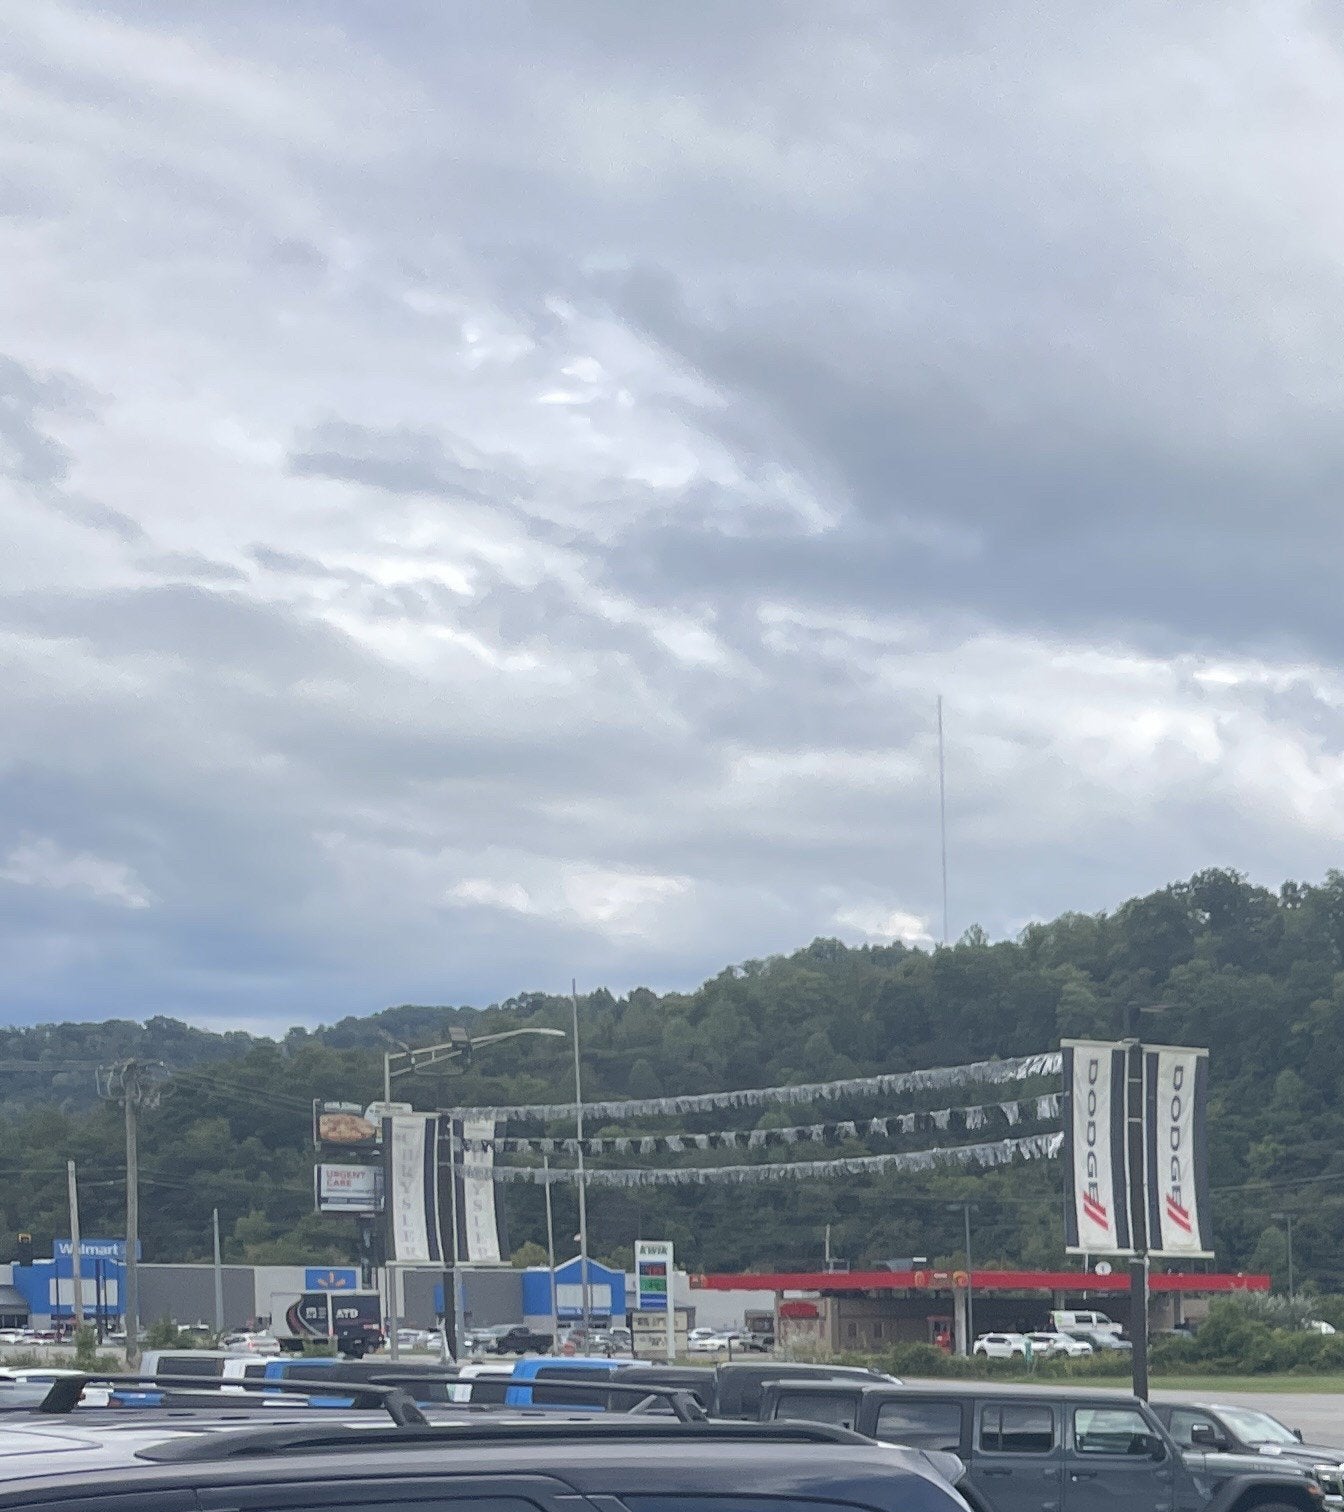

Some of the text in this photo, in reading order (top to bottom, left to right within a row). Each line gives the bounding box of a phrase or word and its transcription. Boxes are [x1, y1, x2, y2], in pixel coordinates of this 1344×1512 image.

[1087, 1059, 1099, 1206] DODGE
[1170, 1065, 1184, 1207] DODGE
[326, 1170, 366, 1179] URGENT
[59, 1243, 118, 1255] Wlmart
